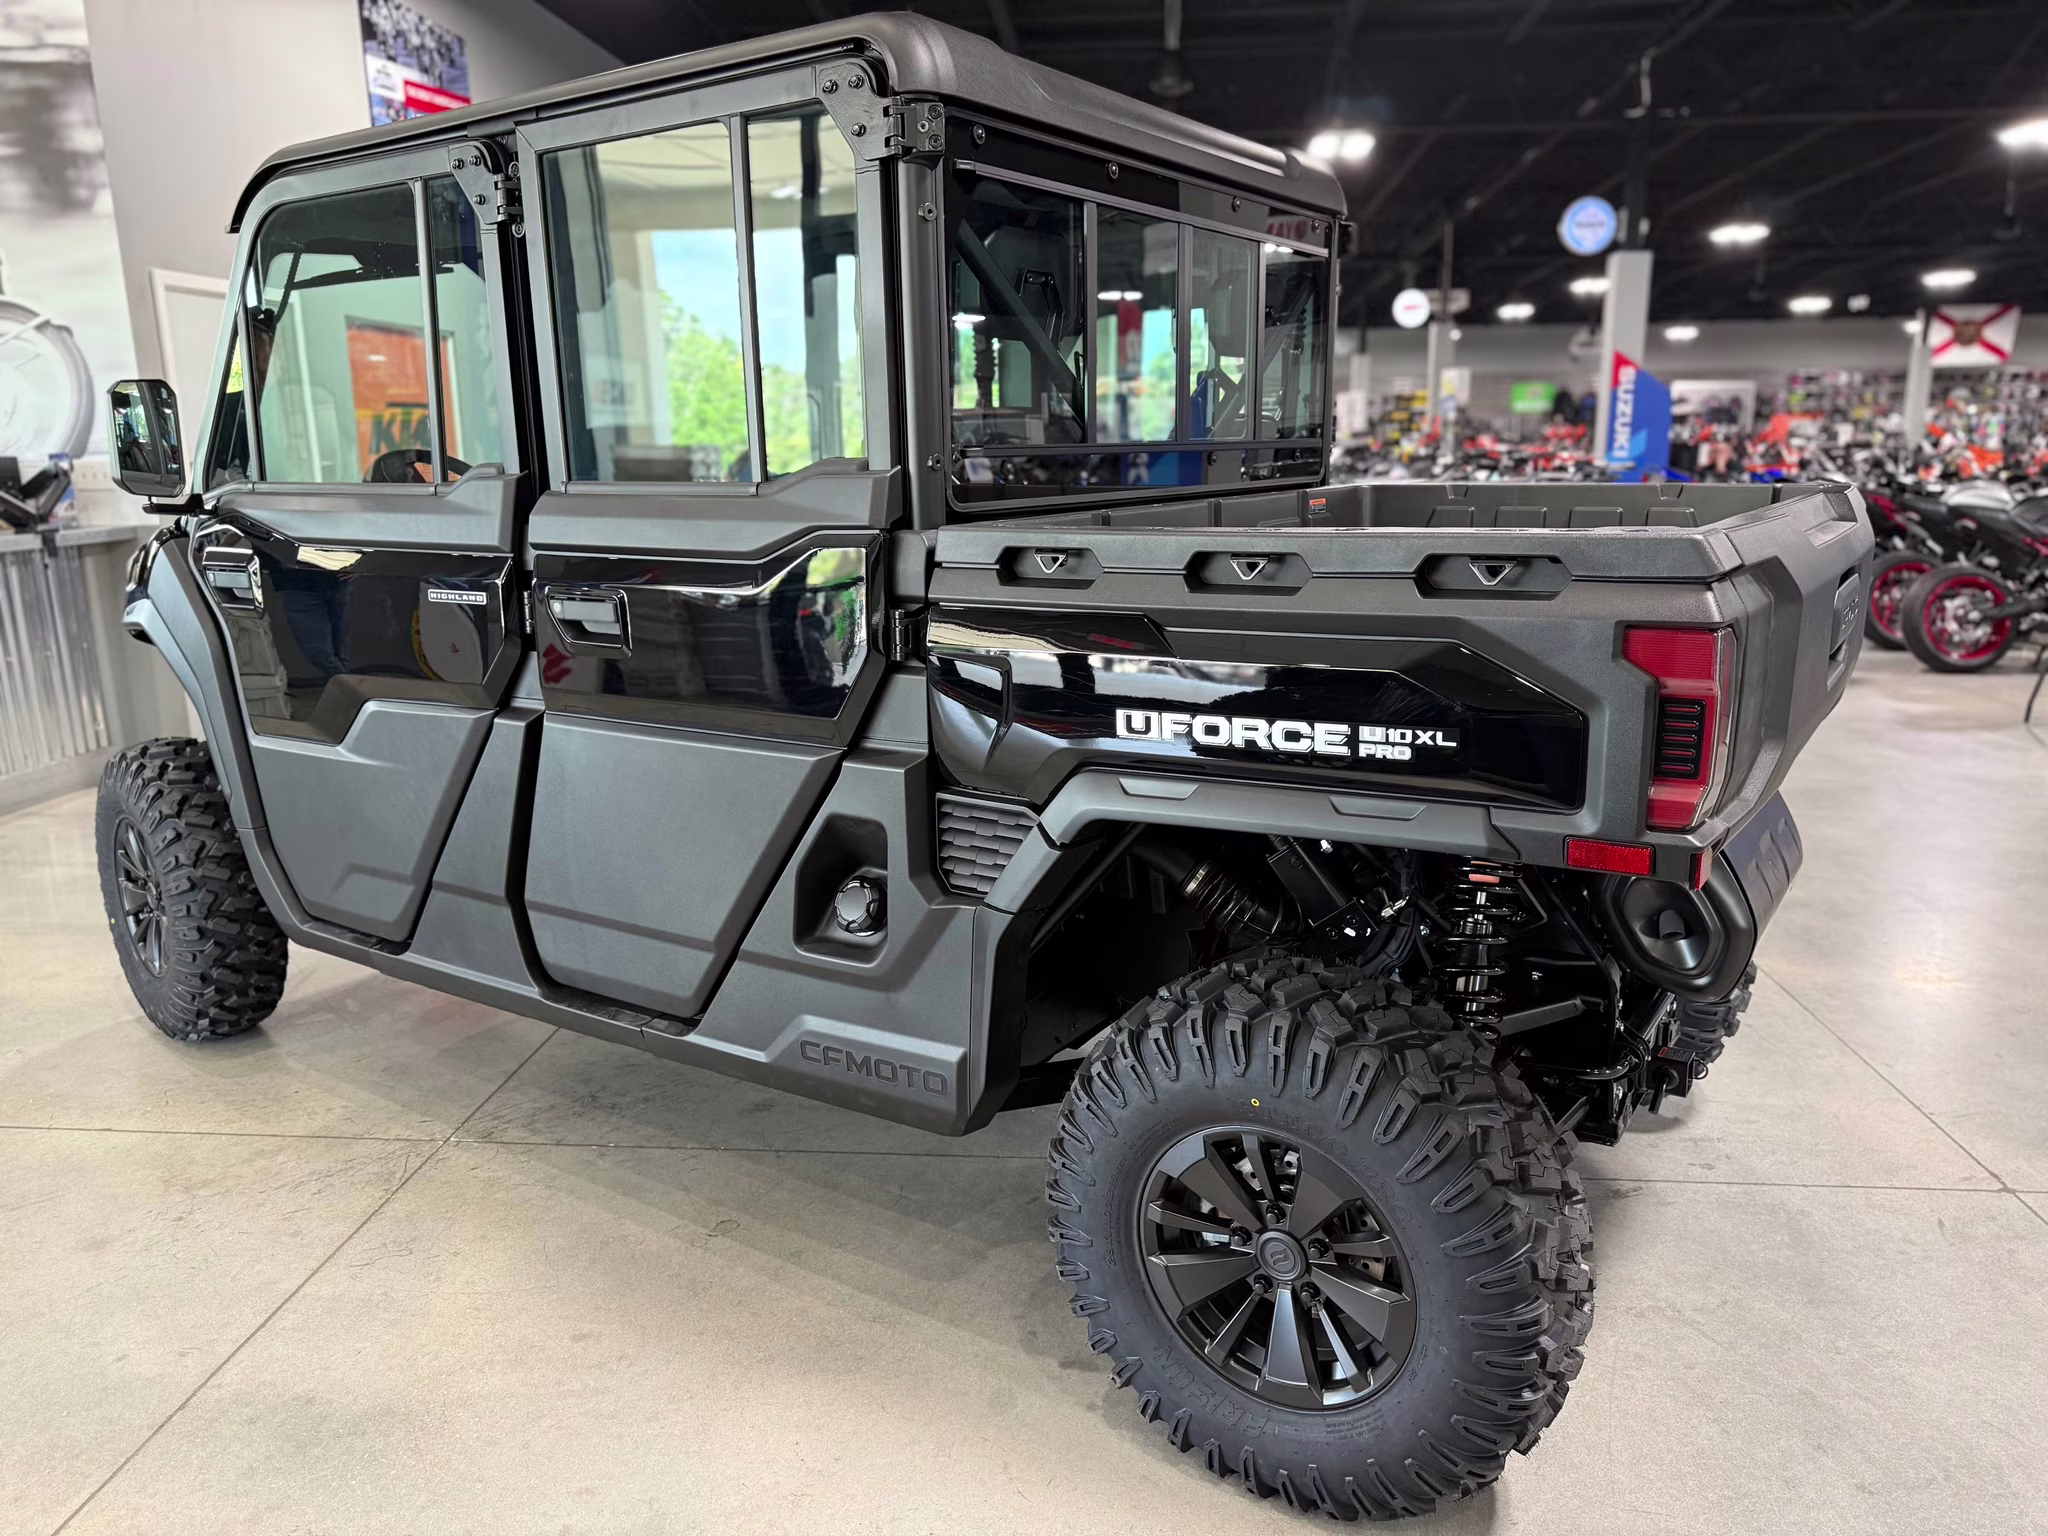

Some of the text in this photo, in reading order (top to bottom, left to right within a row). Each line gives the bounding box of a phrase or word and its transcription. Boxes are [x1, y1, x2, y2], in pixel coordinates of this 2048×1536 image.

[1613, 364, 1637, 458] SUZUKI
[429, 592, 484, 602] HIGHLAND
[1115, 708, 1351, 756] UFORCE
[1359, 743, 1413, 761] PRO
[800, 1040, 949, 1097] CFMOTO
